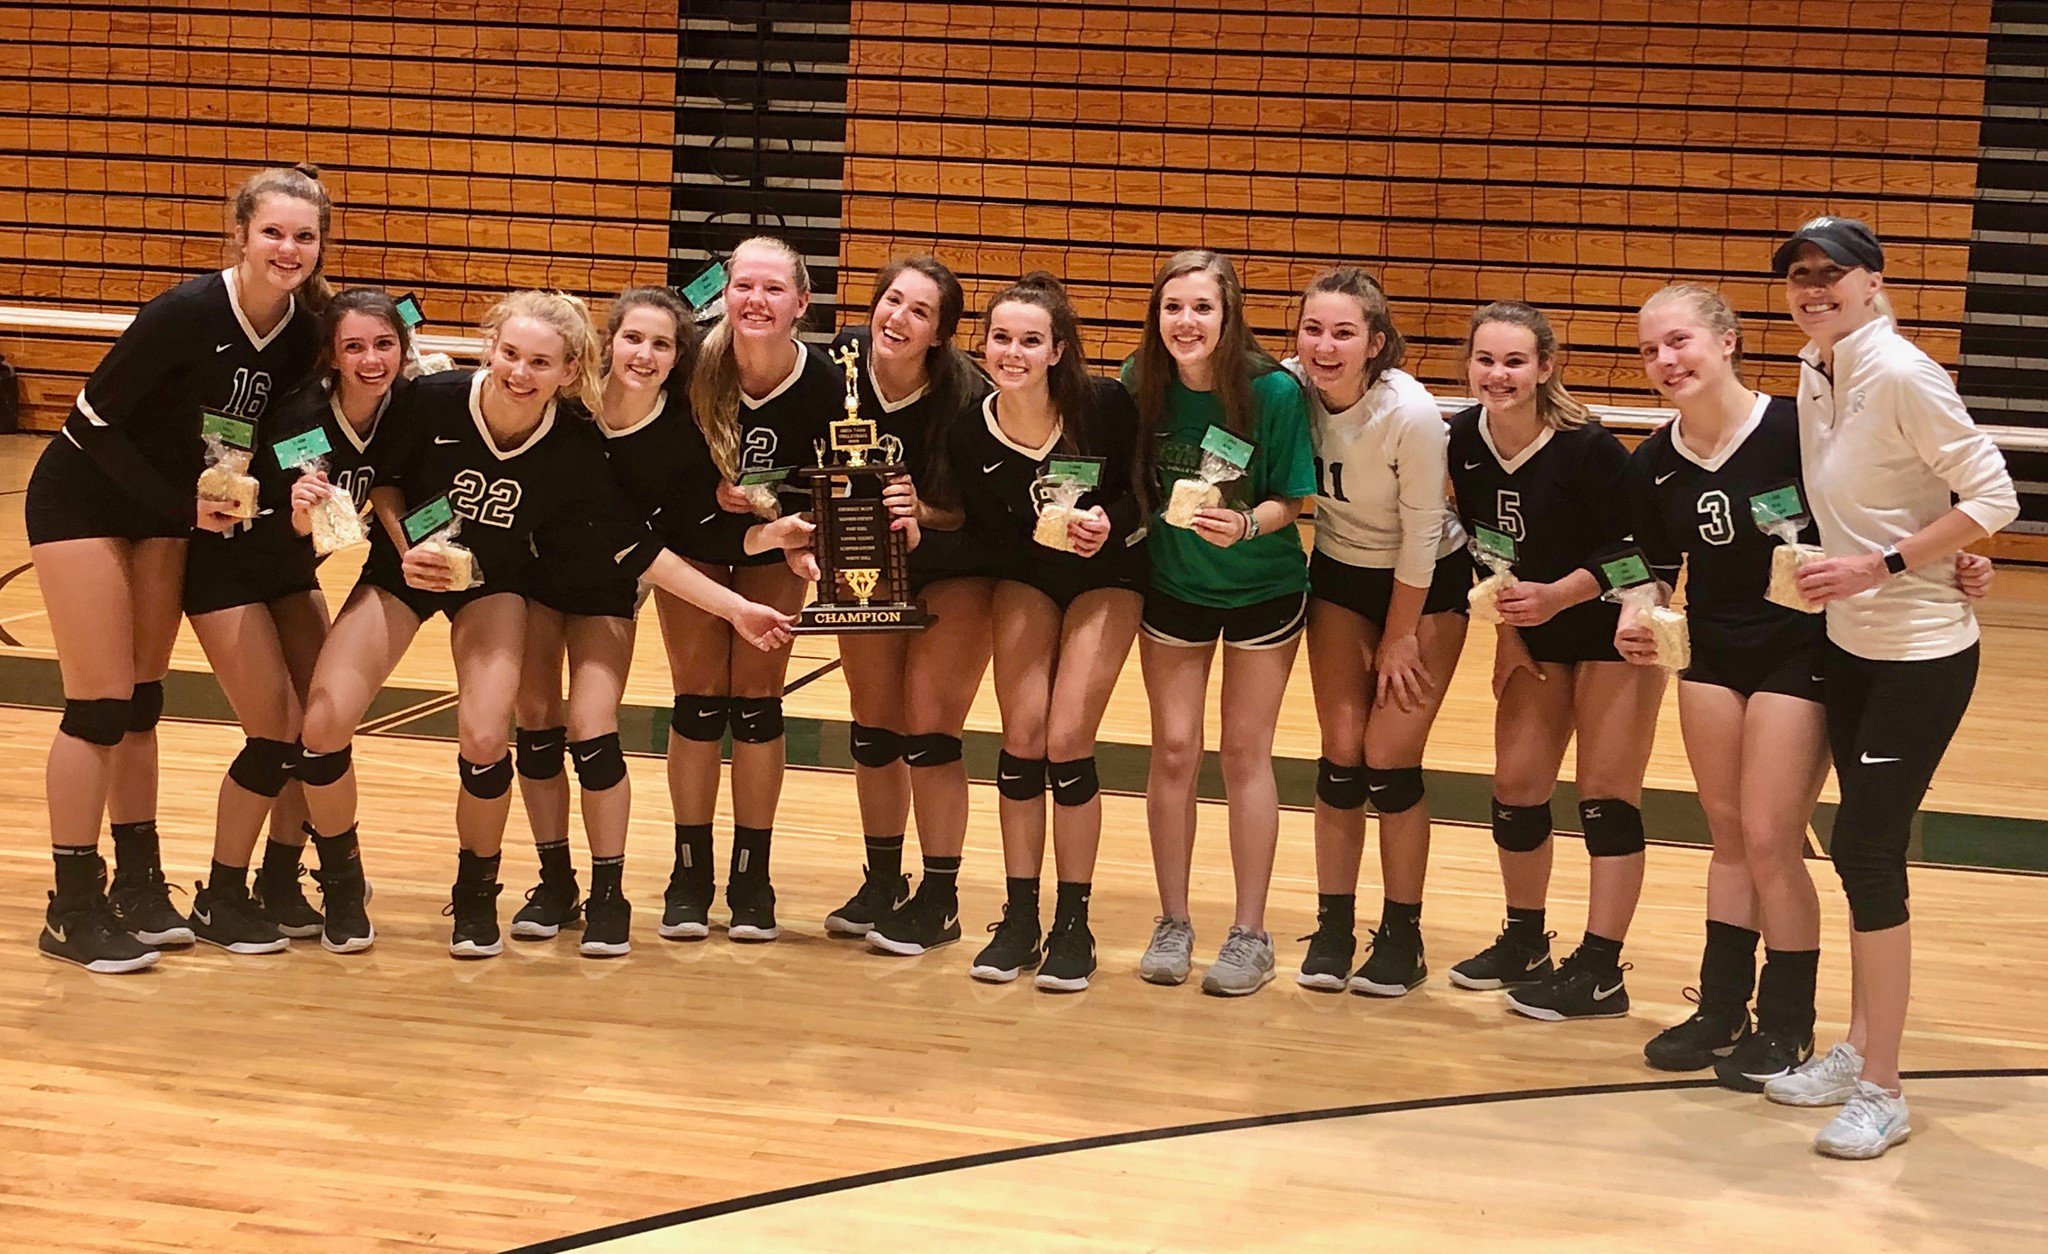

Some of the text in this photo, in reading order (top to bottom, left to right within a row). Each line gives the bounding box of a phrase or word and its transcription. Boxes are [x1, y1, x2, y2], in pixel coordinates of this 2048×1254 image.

[222, 367, 272, 418] 16
[738, 425, 778, 470] 2
[336, 465, 376, 511] 10
[448, 469, 522, 529] 22
[1313, 456, 1351, 503] 11
[1497, 489, 1526, 542] 5
[1697, 489, 1735, 546] 3
[814, 611, 901, 624] CHAMPION
